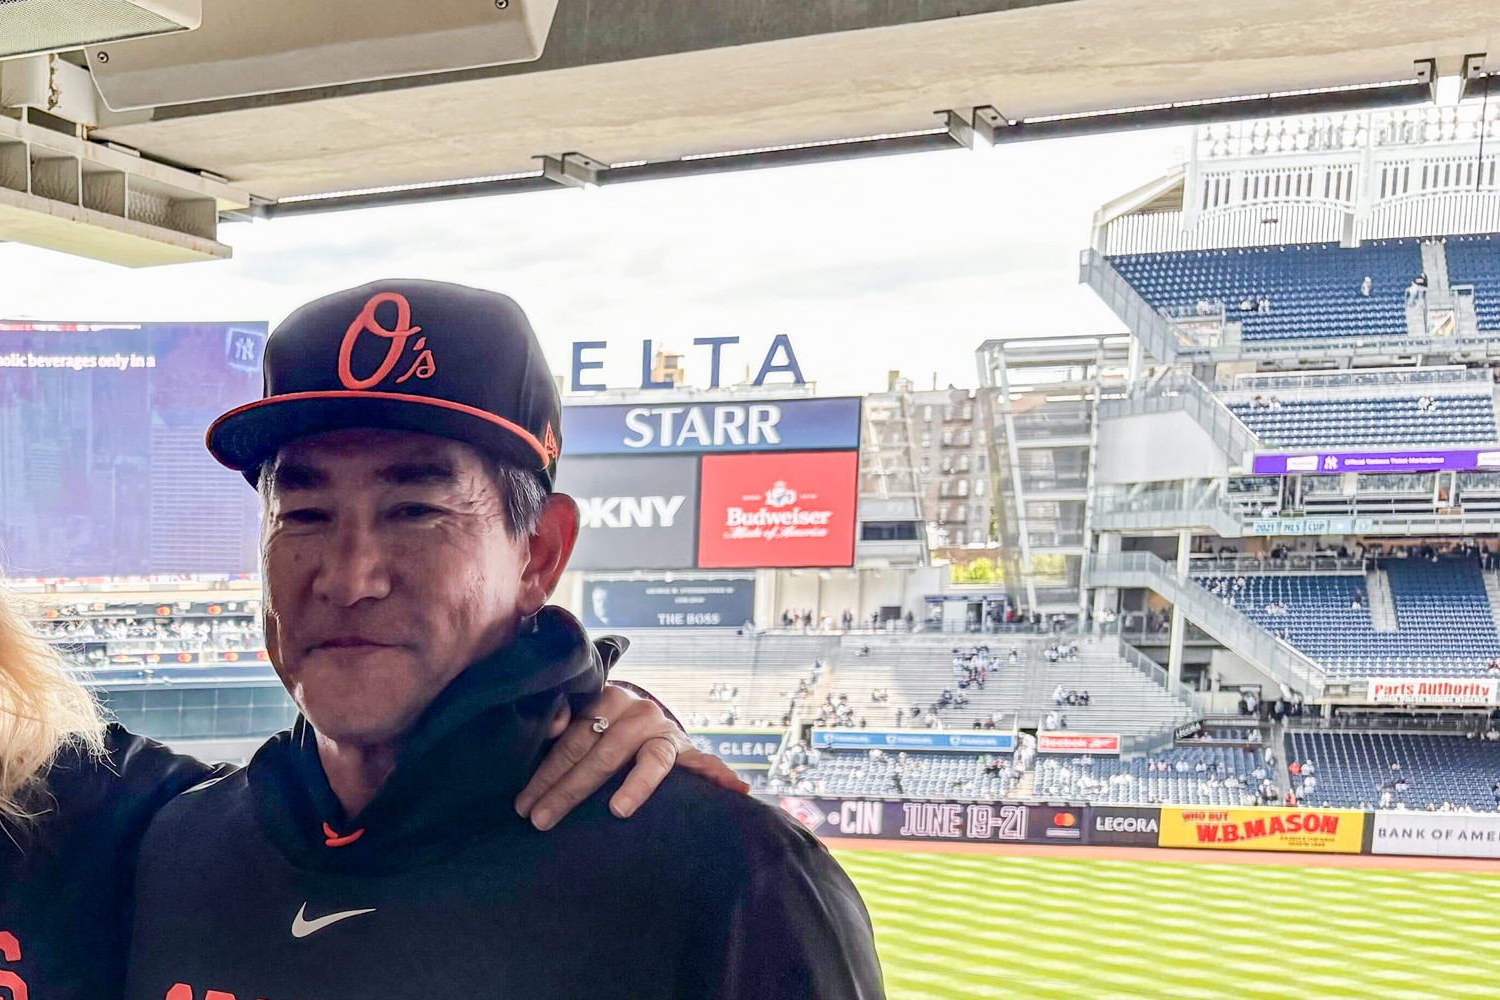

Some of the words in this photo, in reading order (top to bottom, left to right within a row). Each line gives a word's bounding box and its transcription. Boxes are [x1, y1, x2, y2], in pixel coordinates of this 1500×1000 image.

[338, 292, 436, 390] O's
[28, 353, 98, 370] beverages
[99, 354, 129, 370] only
[130, 354, 145, 367] in
[146, 357, 156, 368] a
[571, 334, 806, 392] ELTA
[623, 405, 781, 448] STARR
[725, 507, 832, 526] Budweiser
[658, 613, 683, 625] THE
[687, 613, 720, 625] BOSS
[1375, 684, 1414, 695] Parts
[1418, 682, 1490, 696] Authority
[719, 742, 777, 756] CLEAR
[1040, 737, 1087, 748] Reebok
[840, 801, 882, 835] CIN
[900, 803, 963, 838] JUNE
[967, 805, 1029, 840] 19-21
[1096, 816, 1158, 833] LEGORA
[1378, 827, 1425, 840] BANK
[1432, 829, 1454, 841] OF
